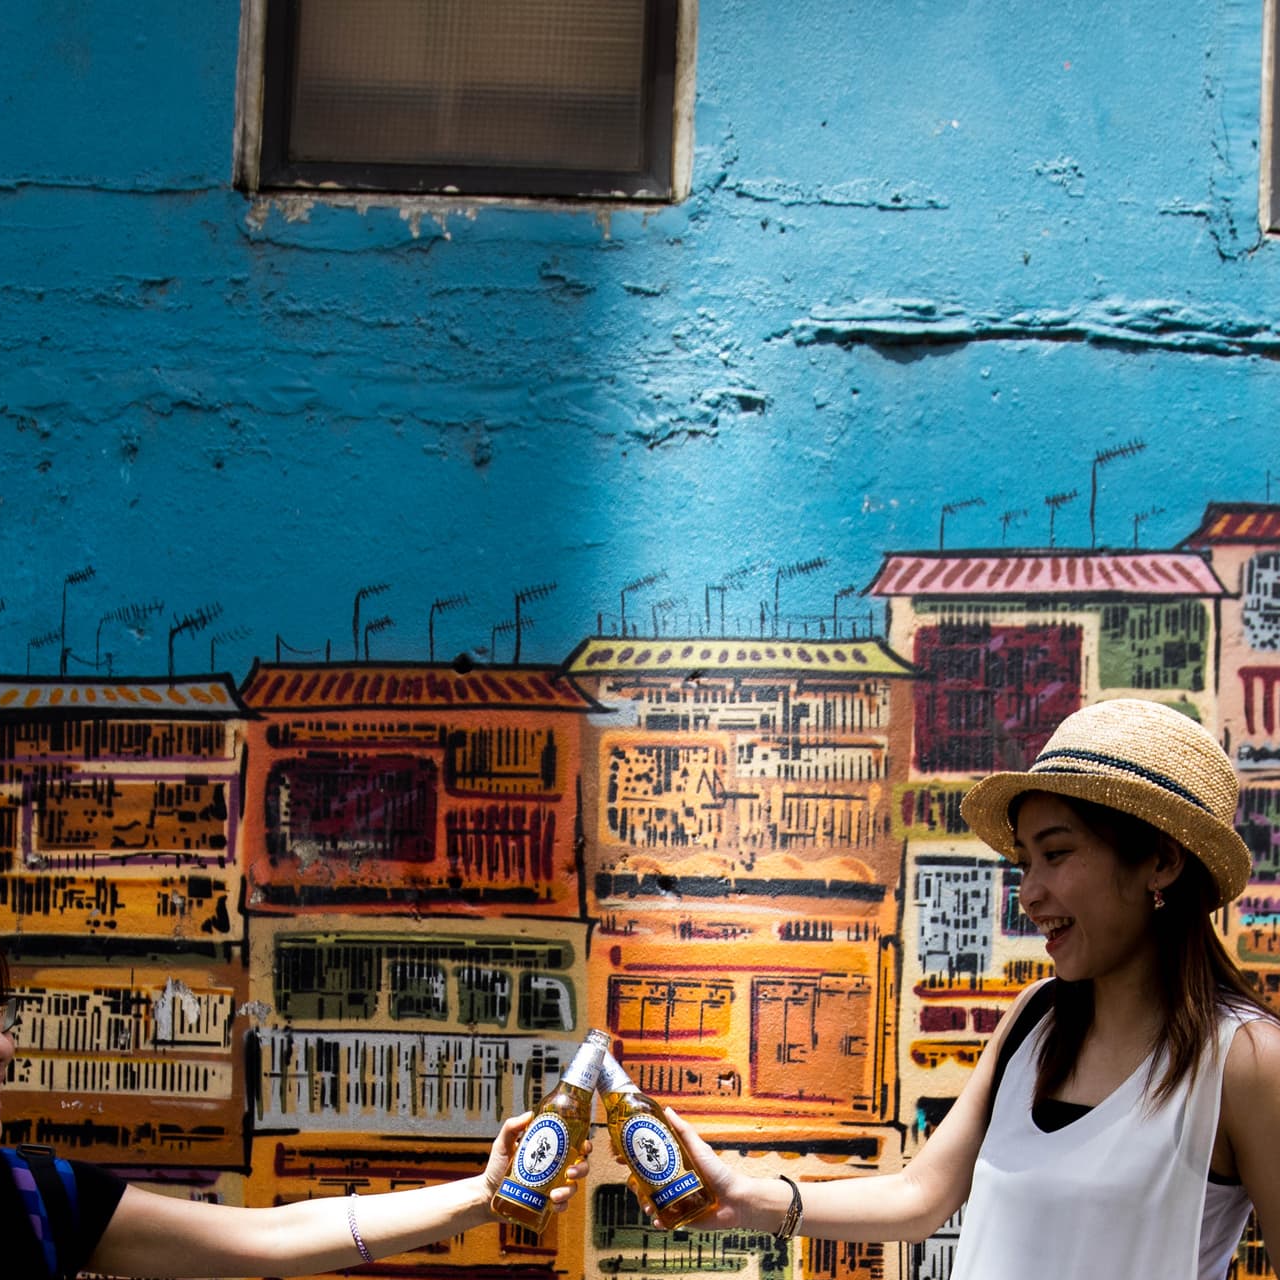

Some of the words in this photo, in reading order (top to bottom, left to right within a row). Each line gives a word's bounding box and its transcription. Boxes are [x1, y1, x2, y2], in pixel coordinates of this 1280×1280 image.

[502, 1183, 522, 1197] BLUE
[521, 1192, 543, 1207] GIRL
[655, 1188, 675, 1205] BLUE
[674, 1176, 696, 1192] GIRL
